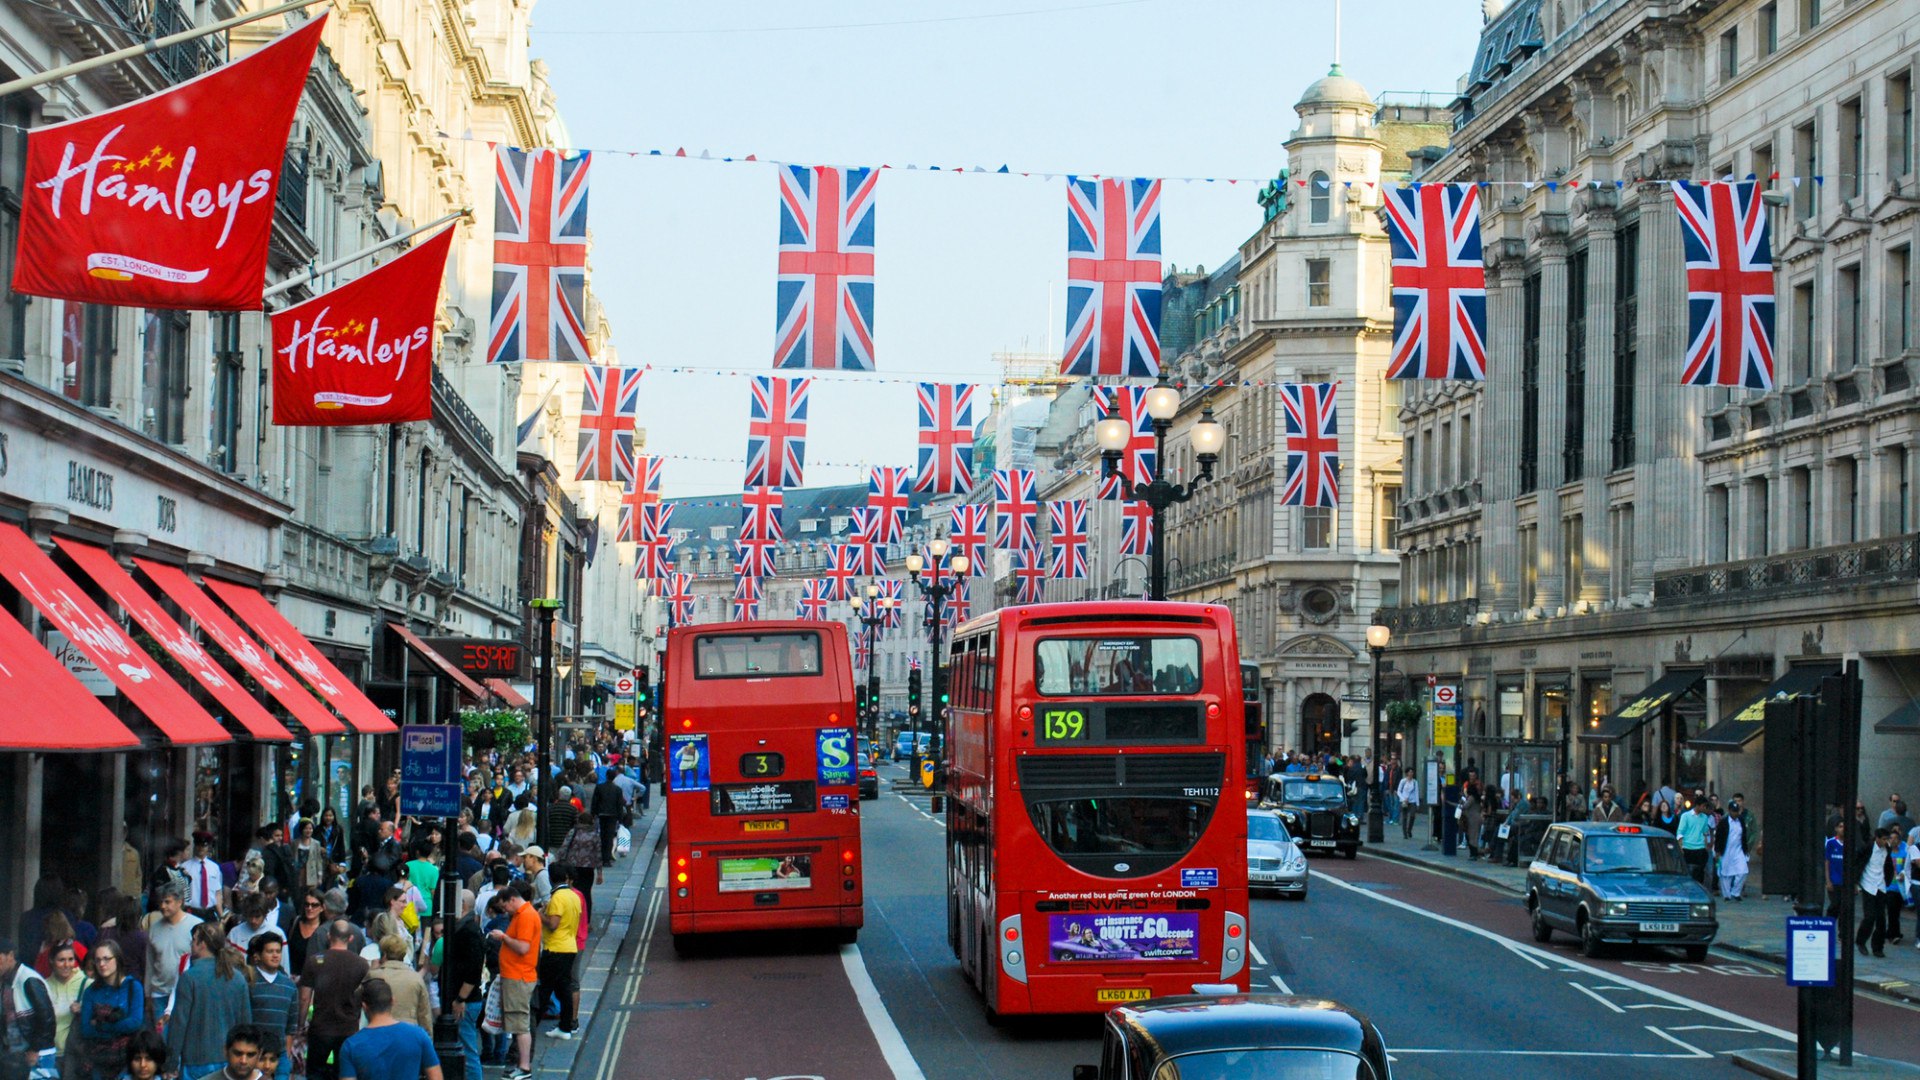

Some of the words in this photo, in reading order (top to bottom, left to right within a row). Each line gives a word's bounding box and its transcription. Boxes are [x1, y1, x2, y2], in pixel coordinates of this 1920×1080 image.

[35, 123, 273, 250] Hamleys
[100, 256, 120, 267] EST.
[123, 259, 161, 276] LONDON
[277, 305, 429, 381] Hamleys
[67, 460, 114, 513] HAMLEYS
[463, 645, 520, 670] ESPRIT
[1427, 676, 1437, 685] M
[1045, 710, 1085, 739] 139
[420, 734, 435, 745] local
[426, 764, 440, 774] taxi
[756, 756, 768, 773] 3
[411, 786, 428, 797] Mon
[434, 787, 449, 798] Sun
[1183, 788, 1220, 797] TEH1112
[426, 800, 458, 813] Midnight
[1049, 892, 1079, 900] Another
[1107, 891, 1128, 901] going
[1128, 892, 1149, 900] green
[1162, 890, 1197, 898] LONDON
[1094, 918, 1107, 926] car
[1107, 915, 1144, 925] insurance
[1100, 925, 1138, 940] QUOTE
[1143, 917, 1169, 939] 60
[1143, 948, 1194, 957] swiftcover.com
[1101, 990, 1126, 1000] LK60
[1128, 990, 1147, 1000] AJX
